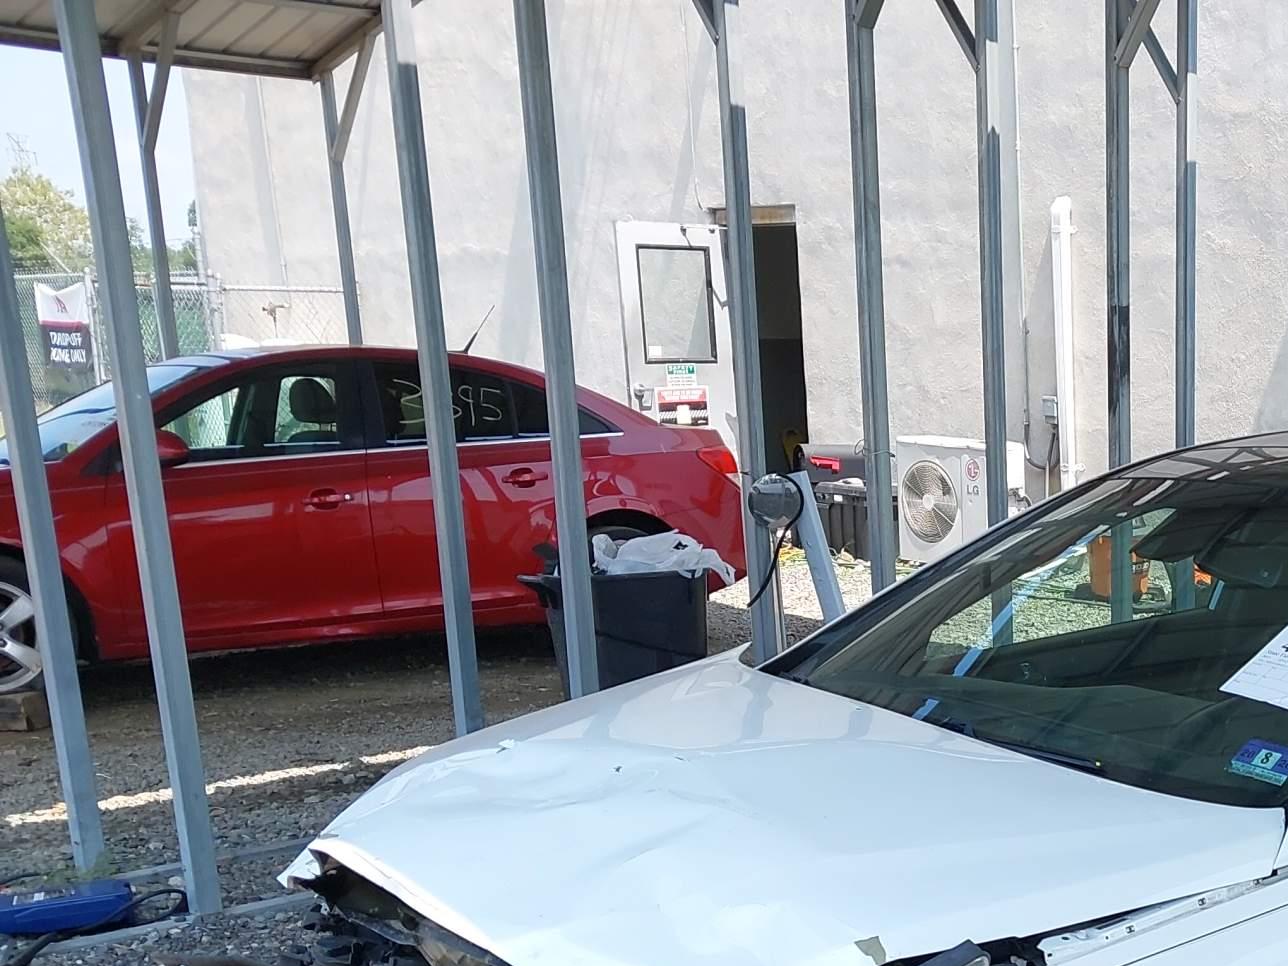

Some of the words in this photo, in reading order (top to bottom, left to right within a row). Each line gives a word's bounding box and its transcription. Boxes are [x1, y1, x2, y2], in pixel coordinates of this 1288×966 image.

[70, 348, 87, 363] ONLY
[392, 378, 502, 427] 395
[966, 484, 980, 495] LG
[1260, 752, 1273, 765] 8
